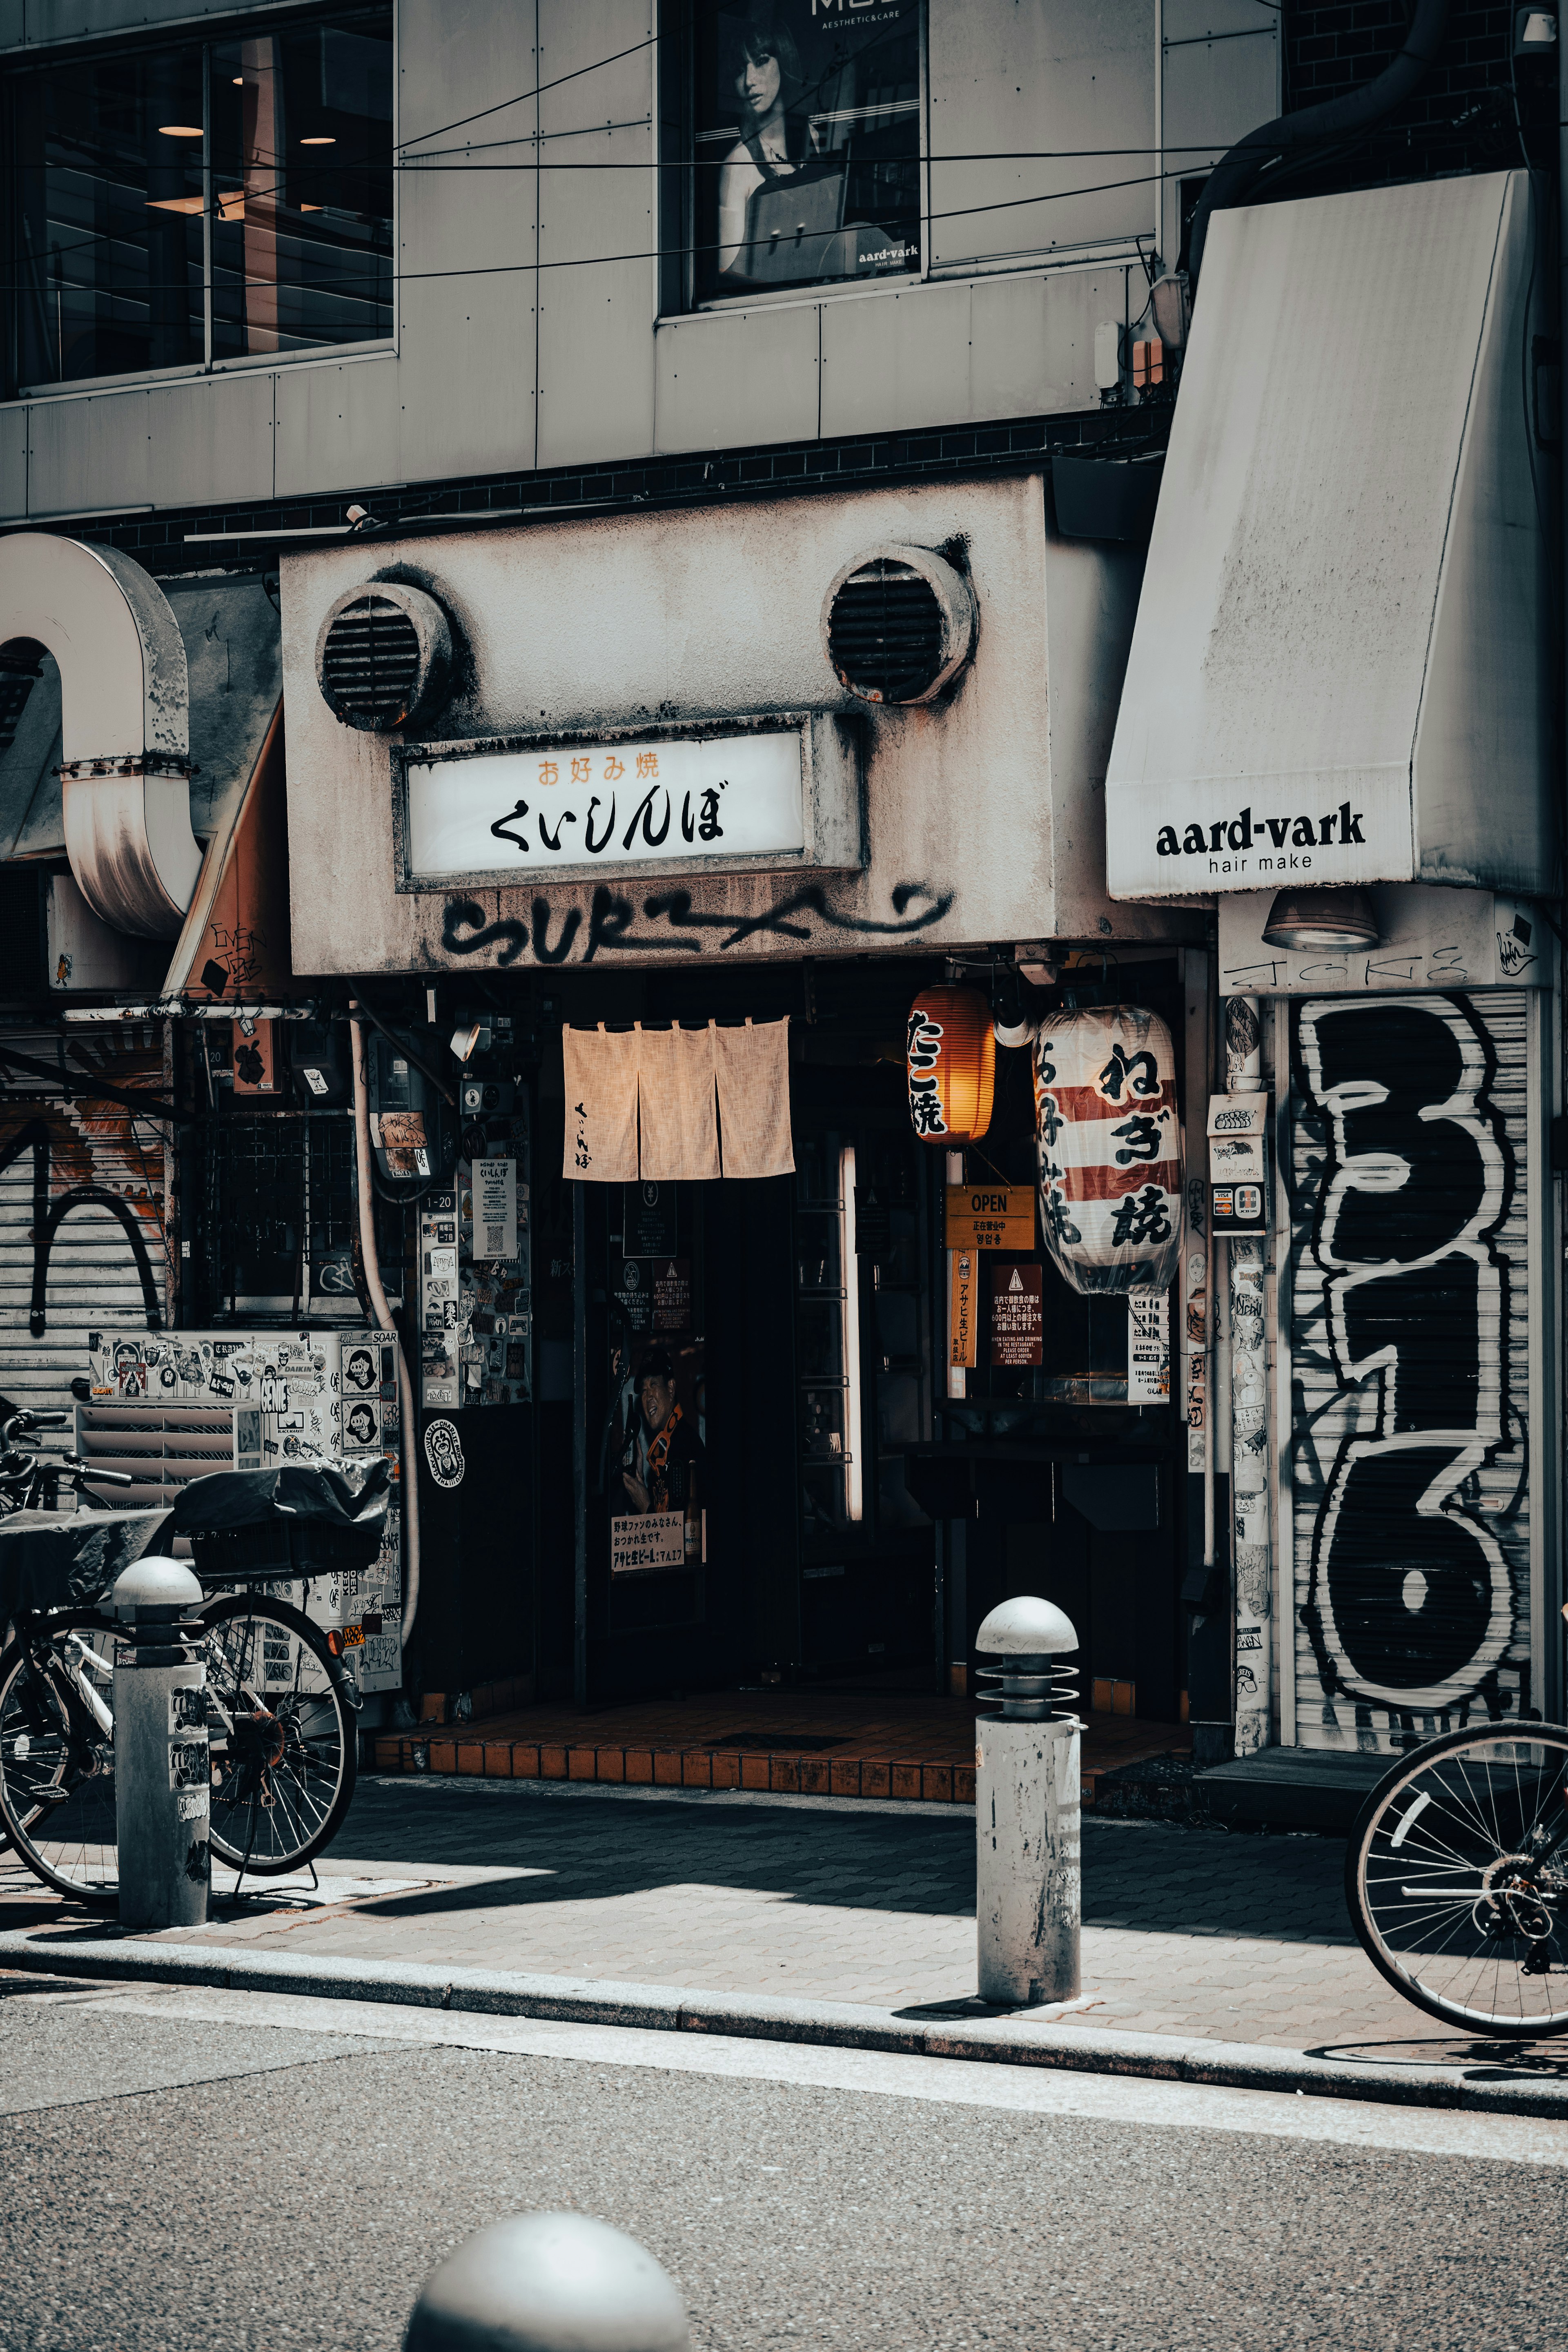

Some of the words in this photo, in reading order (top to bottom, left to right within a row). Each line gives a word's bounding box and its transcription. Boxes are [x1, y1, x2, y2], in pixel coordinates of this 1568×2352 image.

[822, 11, 900, 29] AESTHETIC&CARE
[859, 245, 918, 262] aard-vark
[538, 751, 659, 786] お好み焼
[490, 780, 728, 853] くいしんぼ
[1156, 802, 1365, 856] aard-vark
[1209, 856, 1247, 873] hair
[1259, 853, 1312, 870] make
[1098, 1043, 1172, 1248] ねぎ焼
[480, 1168, 508, 1178] くいしんぼ
[427, 1196, 451, 1208] 1-20
[971, 1194, 1007, 1212] OPEN
[973, 1221, 1005, 1231] 正在营业中
[439, 1233, 453, 1241] 一丁目
[994, 1295, 1040, 1305] 店内で御飲食の際は
[997, 1304, 1035, 1313] お一人様につき、
[959, 1284, 969, 1362] アサヒ生ビール
[991, 1313, 1042, 1322] 600円以上の御注文を
[997, 1322, 1035, 1331] お願い致します。
[373, 1332, 397, 1343] SOAR
[261, 1378, 287, 1412] GENIE
[426, 1424, 435, 1458] UNIVERSE
[439, 1421, 458, 1444] CHARLIE
[430, 1459, 438, 1477] CLAY
[437, 1477, 448, 1486] THE
[614, 1516, 682, 1533] 野球ファンのみなさん、
[614, 1531, 664, 1546] おつかれ生です。
